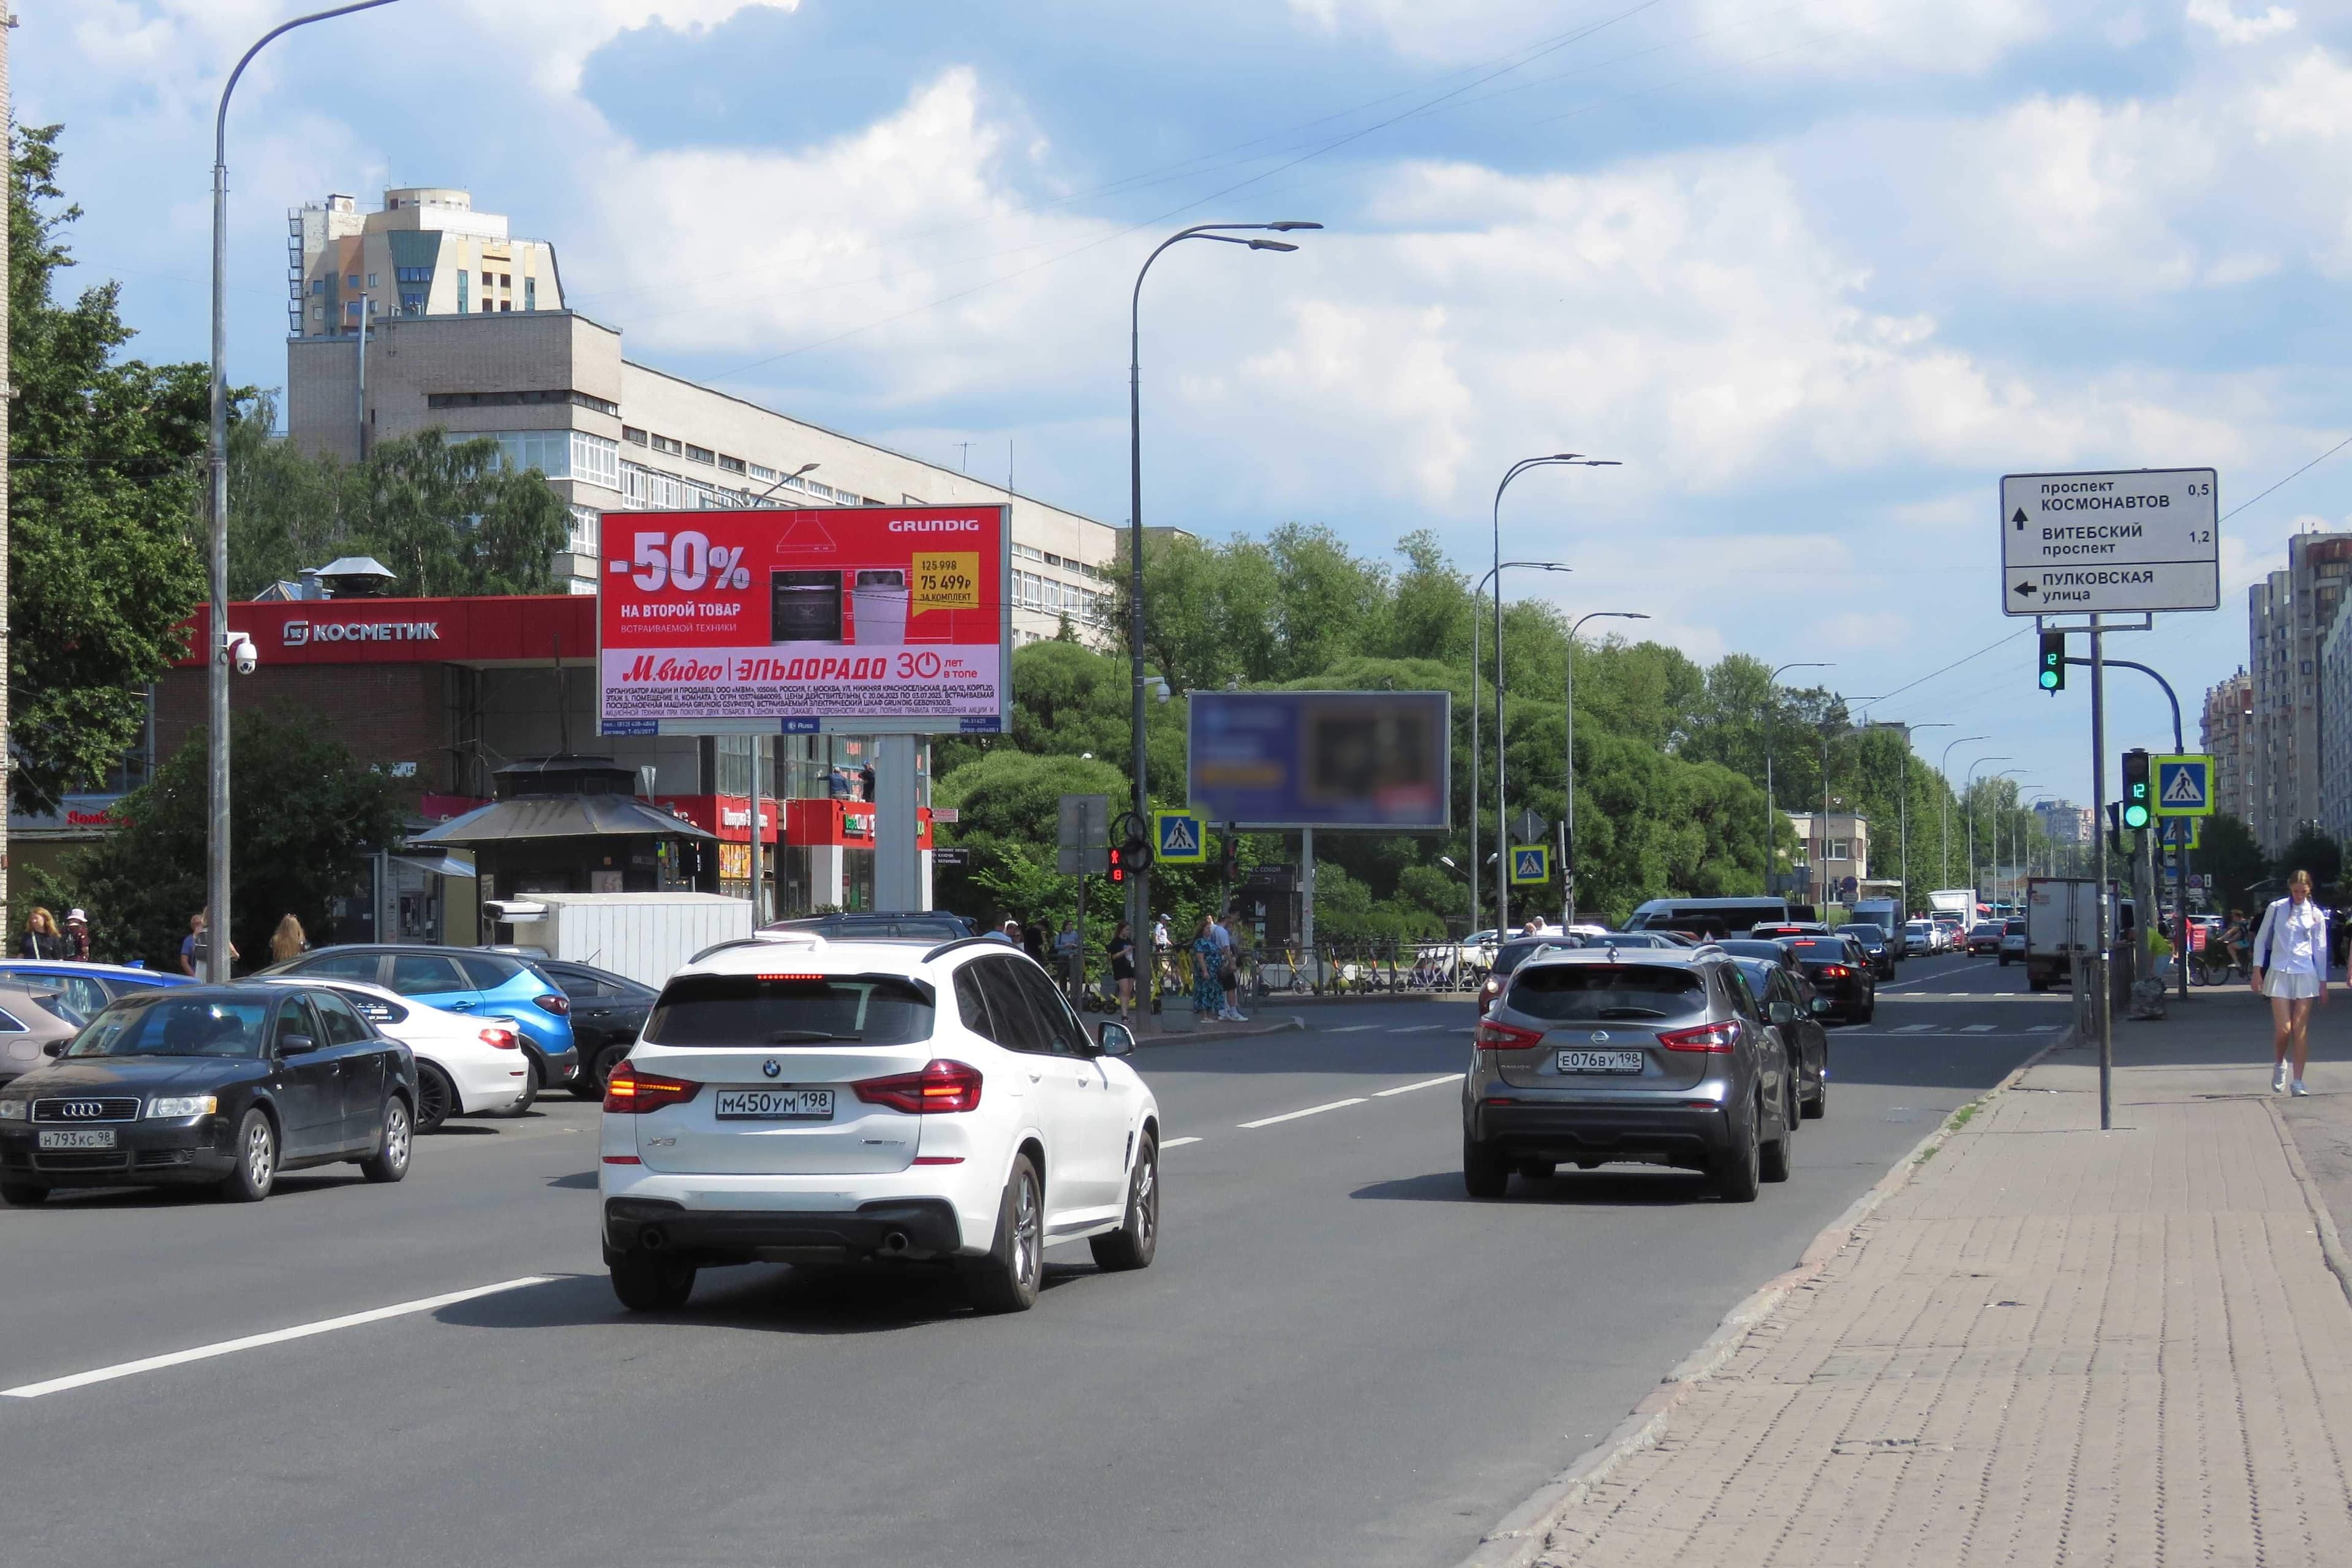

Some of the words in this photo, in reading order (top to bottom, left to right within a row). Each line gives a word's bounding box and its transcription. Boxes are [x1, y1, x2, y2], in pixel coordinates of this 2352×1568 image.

[2041, 482, 2114, 495] проспект
[2188, 484, 2209, 497] 0,5
[2041, 496, 2169, 511] КОСМОНАВТОВ
[889, 520, 979, 532] GRUNDIG
[2043, 522, 2143, 540] ВИТЕБСКИЙ
[2189, 531, 2209, 544] 1,2
[2042, 543, 2116, 557] проспект
[609, 530, 750, 592] -50%
[940, 560, 957, 570] 998
[921, 575, 937, 589] 75
[2043, 571, 2153, 586] ПУЛКОВСКАЯ
[932, 592, 971, 601] КОМПЛЕКТ
[2043, 590, 2090, 603] улица
[621, 605, 639, 617] НА
[643, 601, 695, 617] ВТОРОЙ
[698, 603, 741, 616] ТОВАР
[314, 622, 439, 641] КОСМЕТИК
[621, 622, 693, 633] ВСТРАИВАЕМОЙ
[896, 652, 941, 679] 30
[943, 658, 963, 668] лет
[2048, 654, 2057, 665] 12
[622, 655, 722, 681] М.видео
[952, 669, 978, 680] топе
[757, 699, 809, 707] ВСТРАИВАЕМЫЙ
[810, 698, 862, 707] ЭЛЕКТРИЧЕСКИЙ
[2133, 783, 2144, 798] 12
[1562, 1053, 1615, 1066] Е076ВУ
[1618, 1053, 1638, 1063] 198
[722, 1093, 796, 1112] М450УМ
[800, 1093, 827, 1107] 198
[44, 1132, 94, 1146] Н793КС
[98, 1131, 110, 1142] 98
